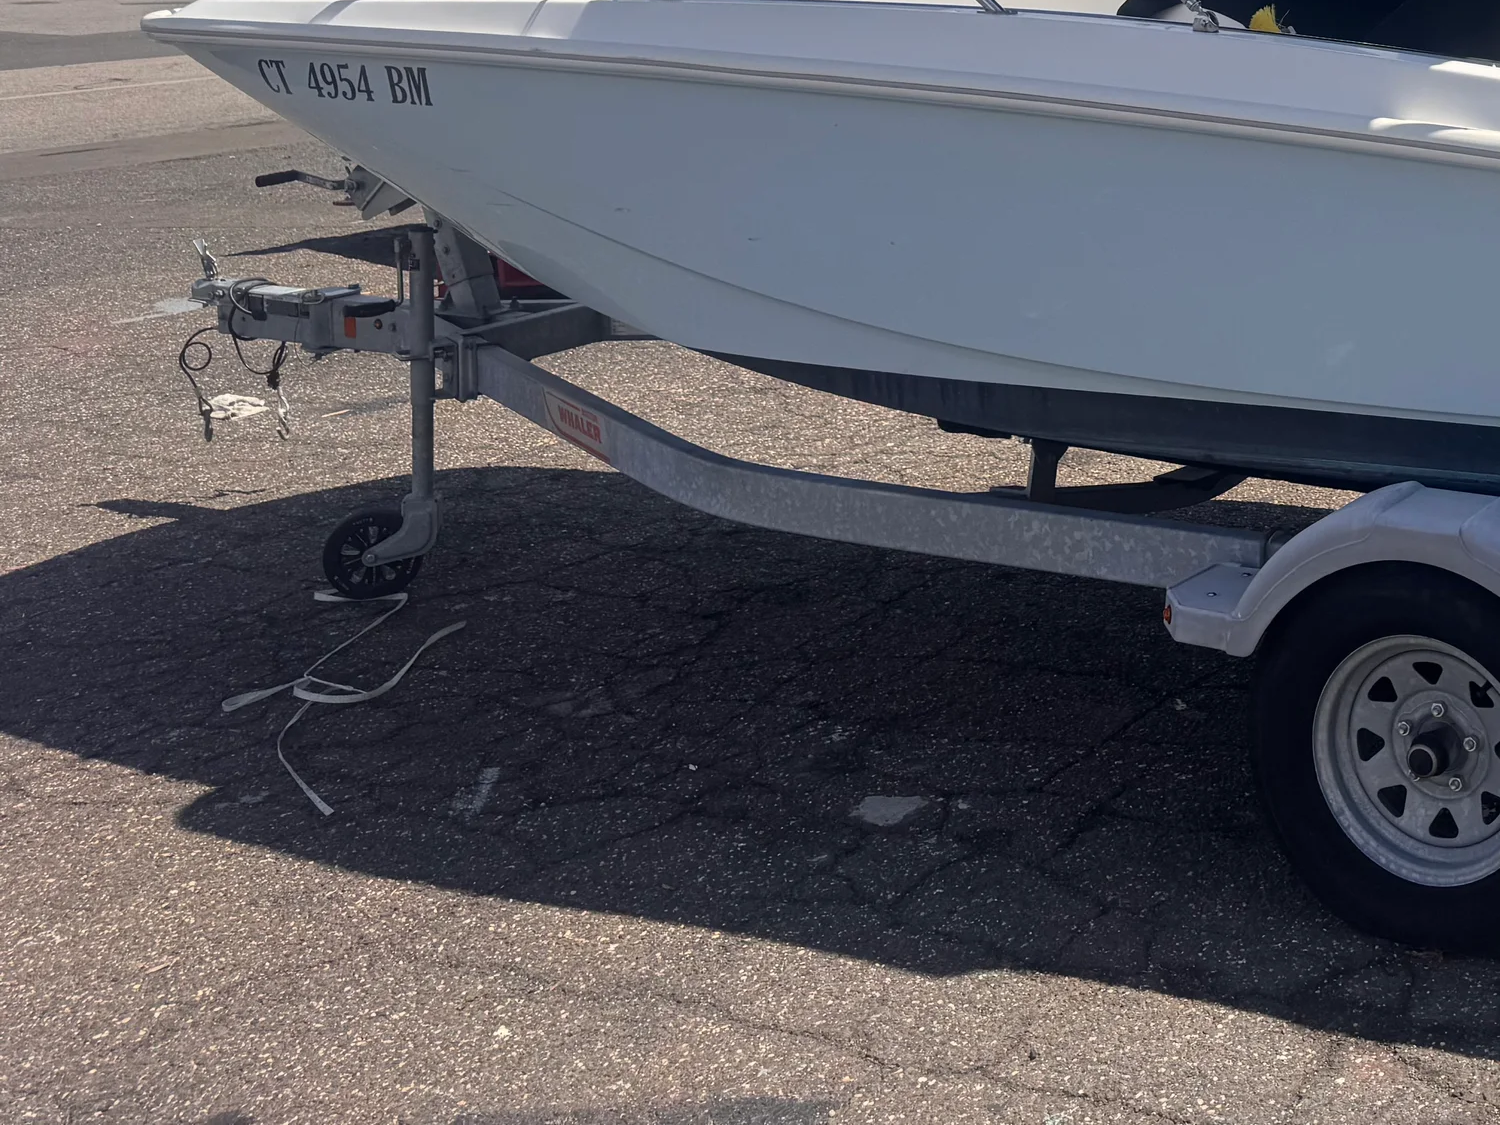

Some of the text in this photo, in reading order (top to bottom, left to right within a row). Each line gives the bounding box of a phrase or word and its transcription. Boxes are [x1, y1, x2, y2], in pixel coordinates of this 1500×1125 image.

[258, 59, 433, 106] CT 4954 BM
[558, 405, 602, 444] WHALER
